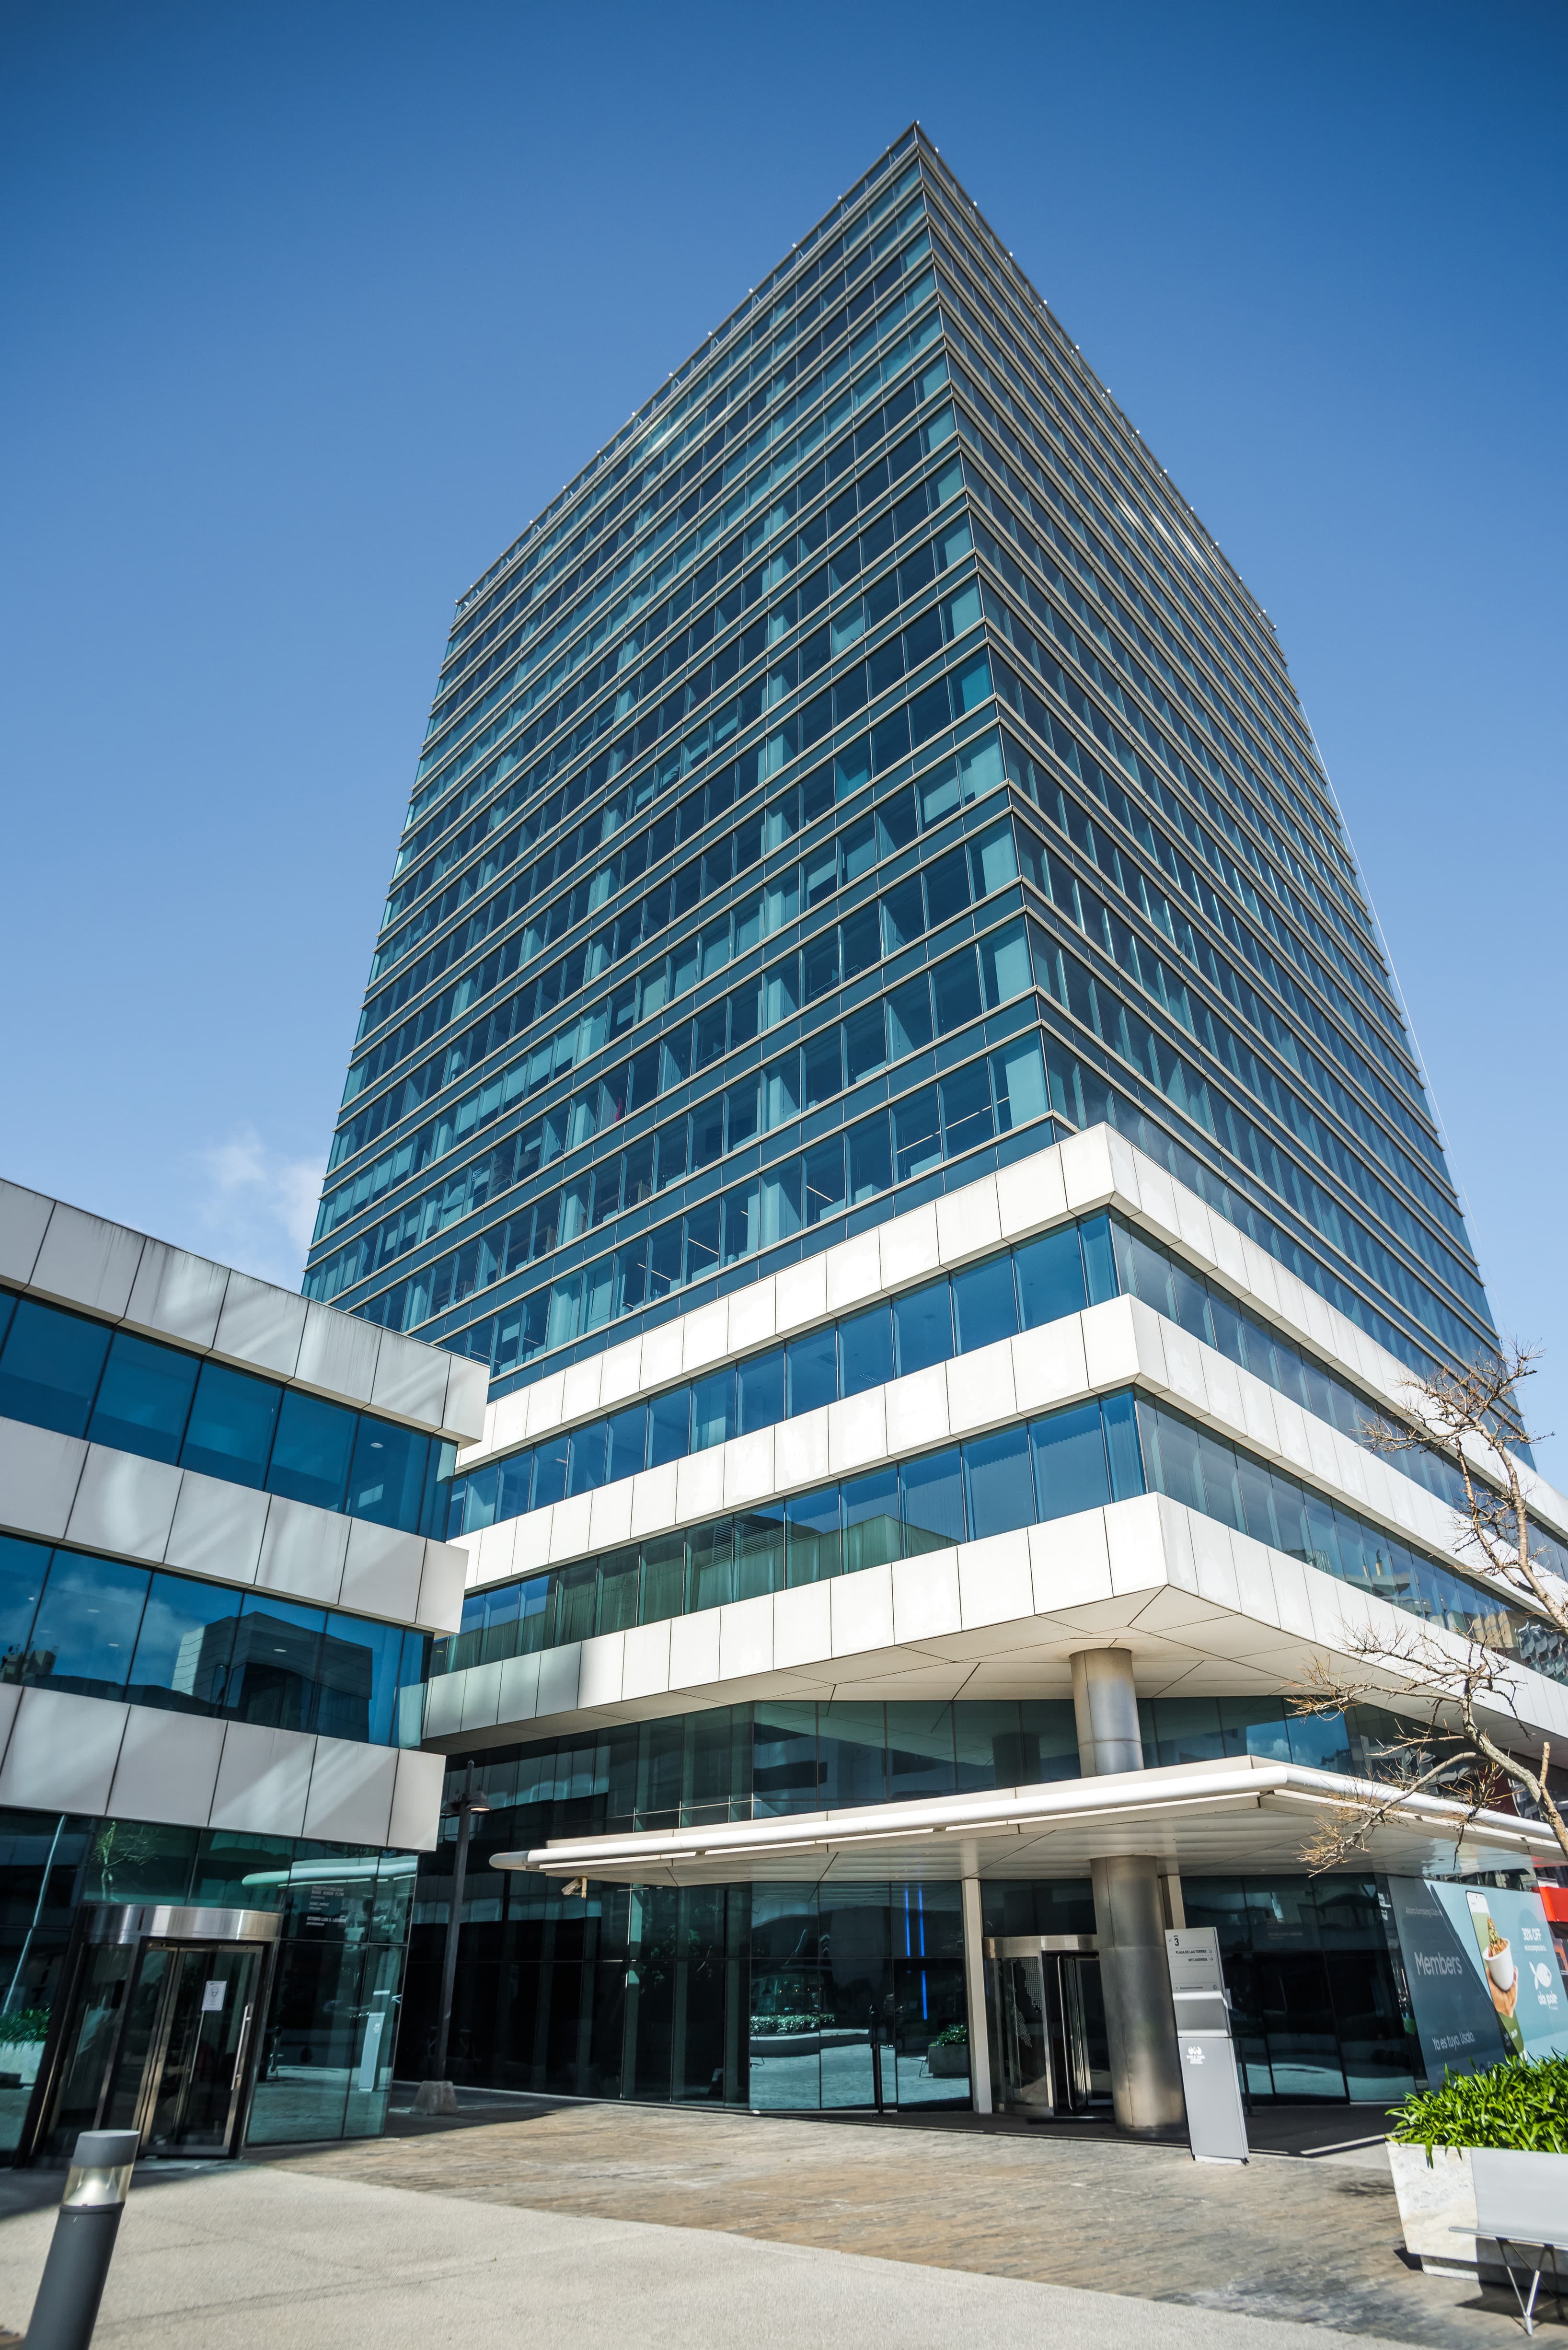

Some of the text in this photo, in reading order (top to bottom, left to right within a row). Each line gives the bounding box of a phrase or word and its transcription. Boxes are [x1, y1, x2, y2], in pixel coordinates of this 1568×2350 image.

[1532, 1927, 1542, 1941] OFF
[1174, 1938, 1179, 1946] 3
[1414, 1951, 1462, 1975] Members
[1431, 2037, 1441, 2051] Ya
[1440, 2037, 1447, 2049] es
